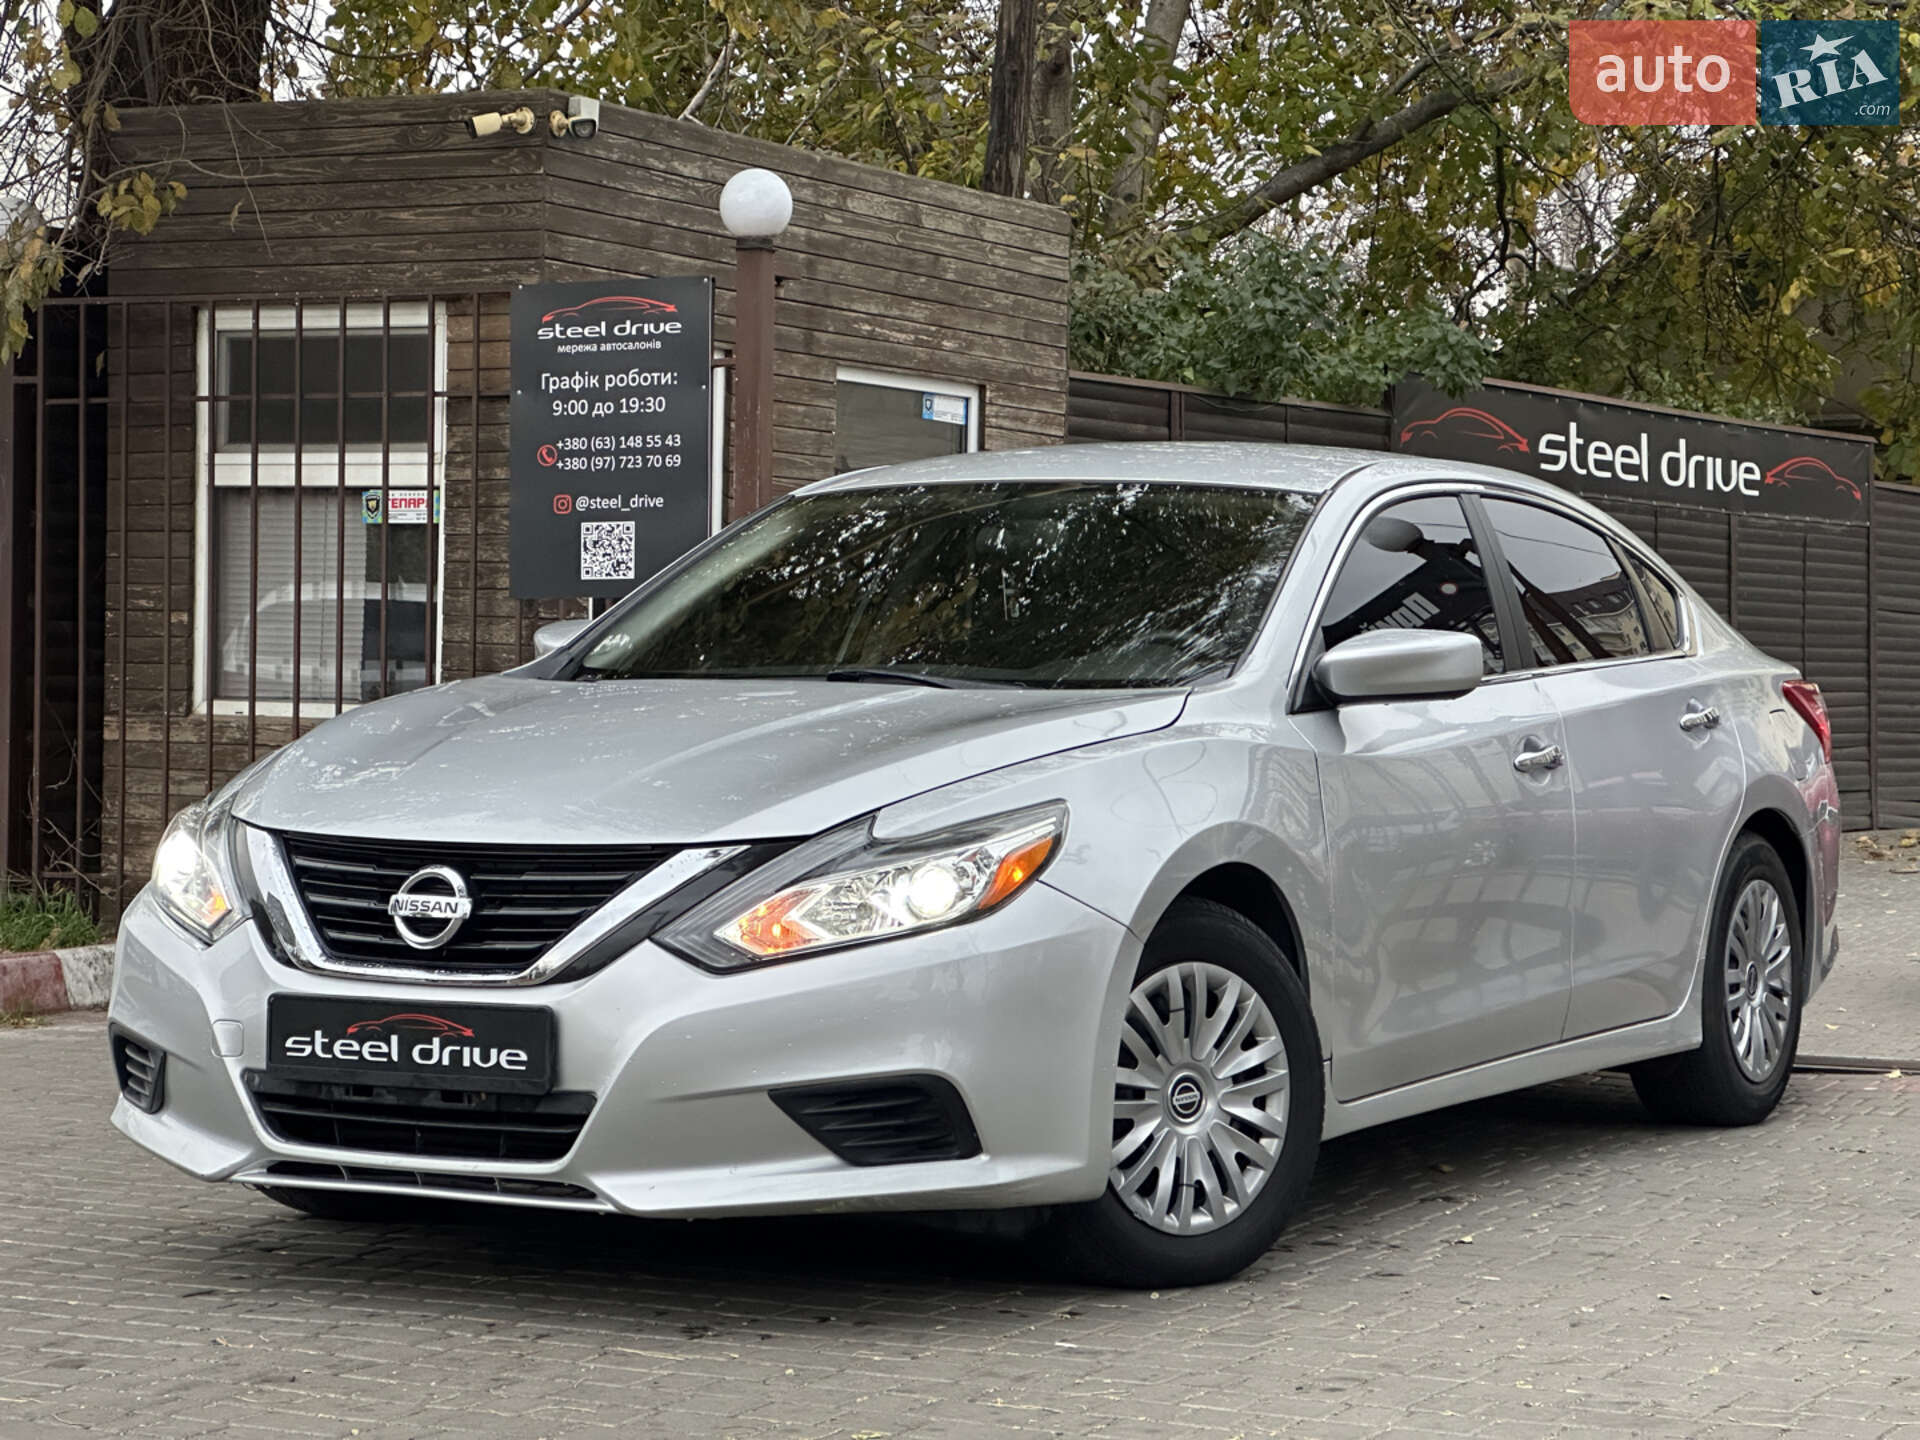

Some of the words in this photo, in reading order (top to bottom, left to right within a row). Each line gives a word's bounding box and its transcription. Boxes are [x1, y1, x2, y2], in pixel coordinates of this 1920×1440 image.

[537, 321, 606, 339] steel
[613, 319, 682, 336] drive
[557, 344, 597, 355] мережа
[600, 339, 662, 352] автосалонів
[541, 371, 599, 393] Графік
[605, 368, 678, 391] роботи:
[552, 399, 588, 416] 9:00
[592, 402, 614, 417] до
[619, 396, 666, 414] 19:30
[556, 437, 587, 450] +380
[591, 435, 616, 452] (63)
[619, 435, 643, 449] 148
[646, 435, 662, 448] 55
[665, 434, 681, 447] 43
[556, 457, 587, 470] +380
[591, 455, 616, 472] (97)
[619, 455, 642, 469] 723
[646, 455, 662, 468] 70
[665, 454, 681, 467] 69
[1537, 421, 1650, 483] steel
[1660, 437, 1761, 497] drive
[388, 498, 428, 509] ЕПАР
[575, 493, 664, 512] @steel_drive
[392, 897, 458, 915] NISSAN
[285, 1029, 399, 1062] steel
[412, 1037, 529, 1070] drive
